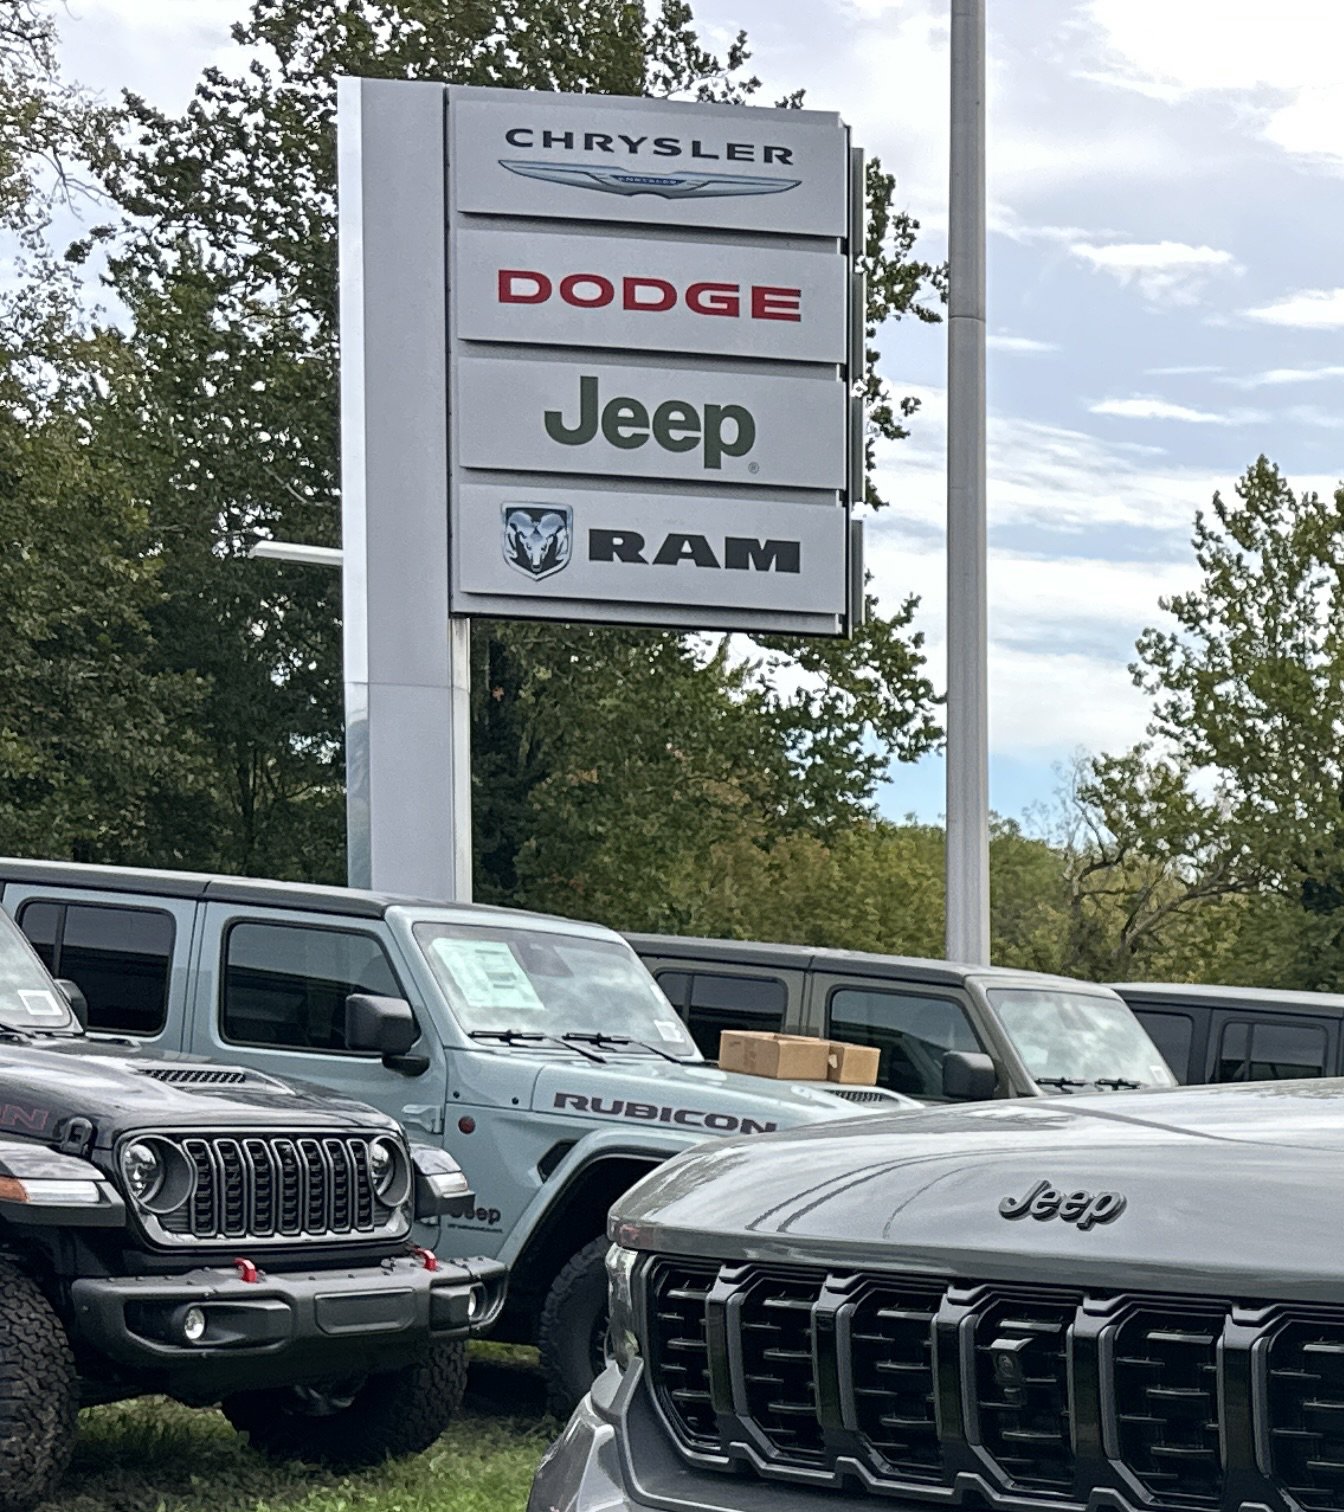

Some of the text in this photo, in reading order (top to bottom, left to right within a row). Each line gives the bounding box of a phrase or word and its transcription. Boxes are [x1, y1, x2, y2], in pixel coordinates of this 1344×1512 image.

[505, 128, 794, 166] CHRYSLER
[498, 269, 802, 323] DODGE
[544, 375, 756, 469] Jeep
[588, 528, 800, 574] RAM
[553, 1092, 777, 1134] RUBICON
[998, 1179, 1128, 1232] Jeep
